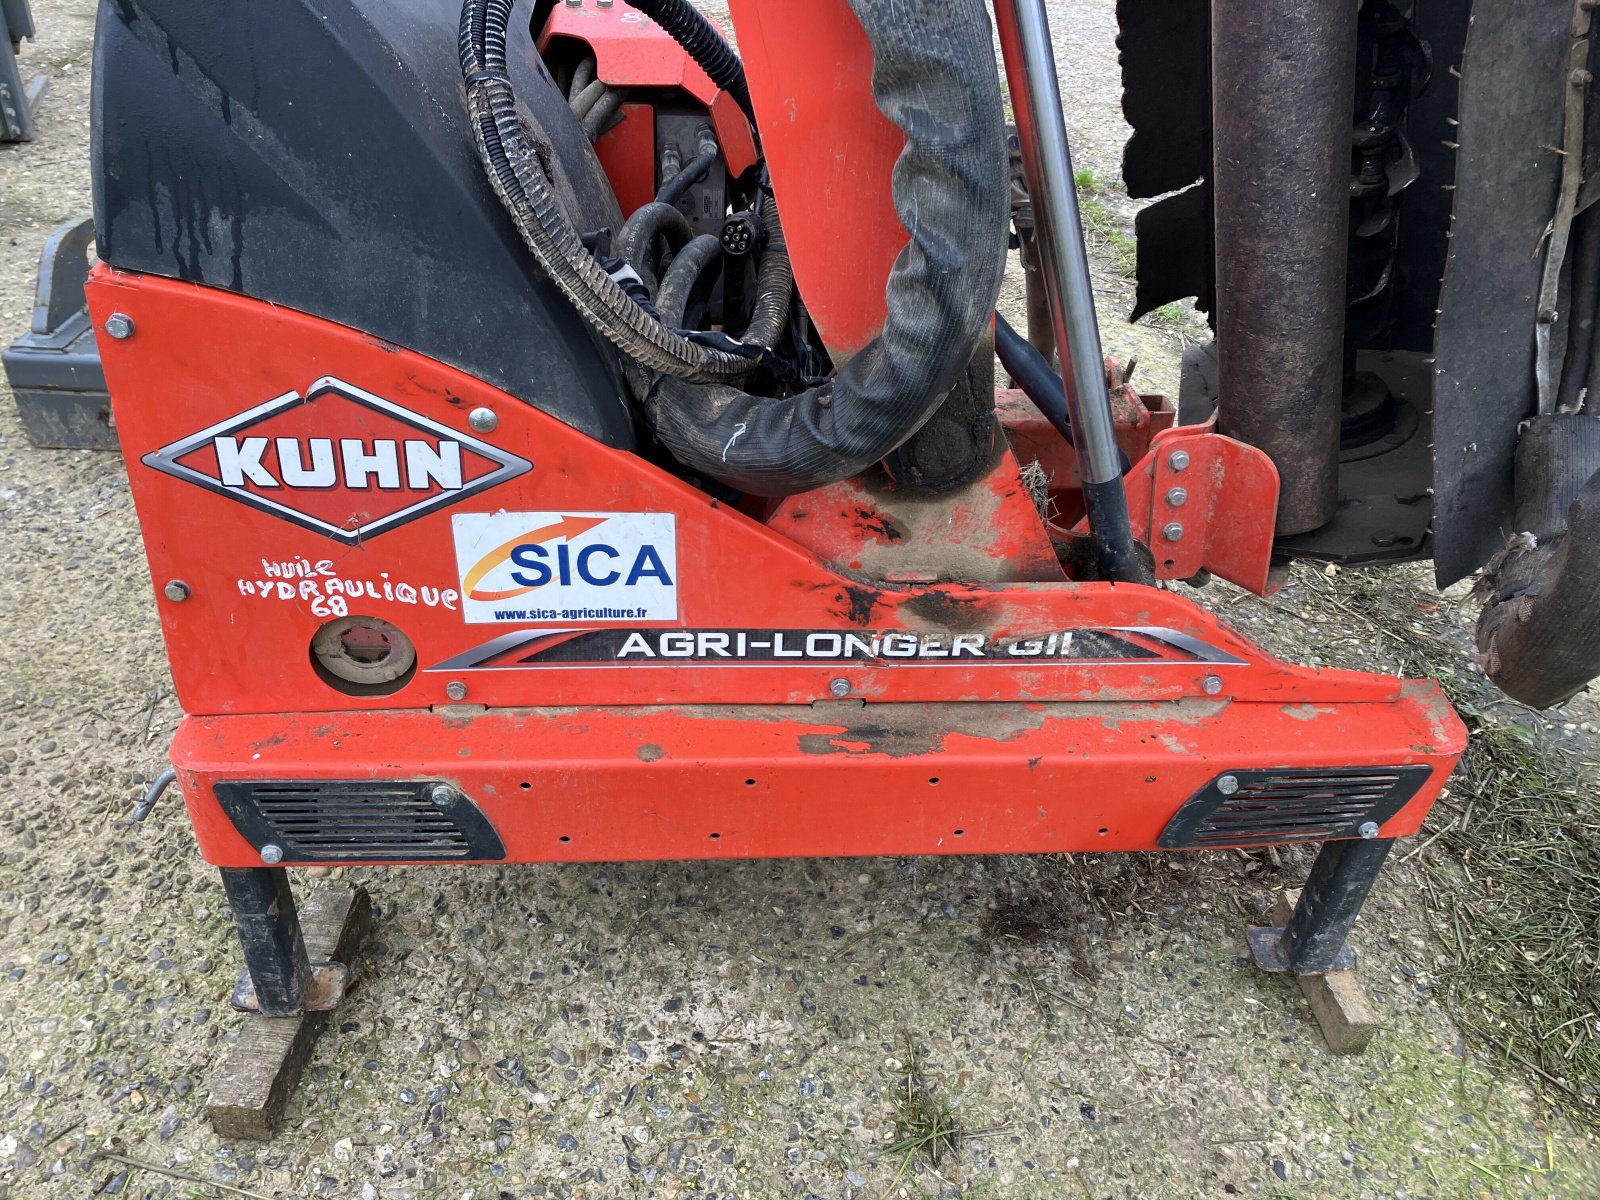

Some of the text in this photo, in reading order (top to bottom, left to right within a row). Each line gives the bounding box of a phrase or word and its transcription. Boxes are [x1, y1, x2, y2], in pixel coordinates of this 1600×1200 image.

[213, 436, 464, 490] KUHN
[510, 543, 674, 587] SICA
[310, 594, 349, 617] 68
[494, 606, 648, 620] www.sica-agriculture.fr
[616, 632, 986, 658] AGRI-LONGER
